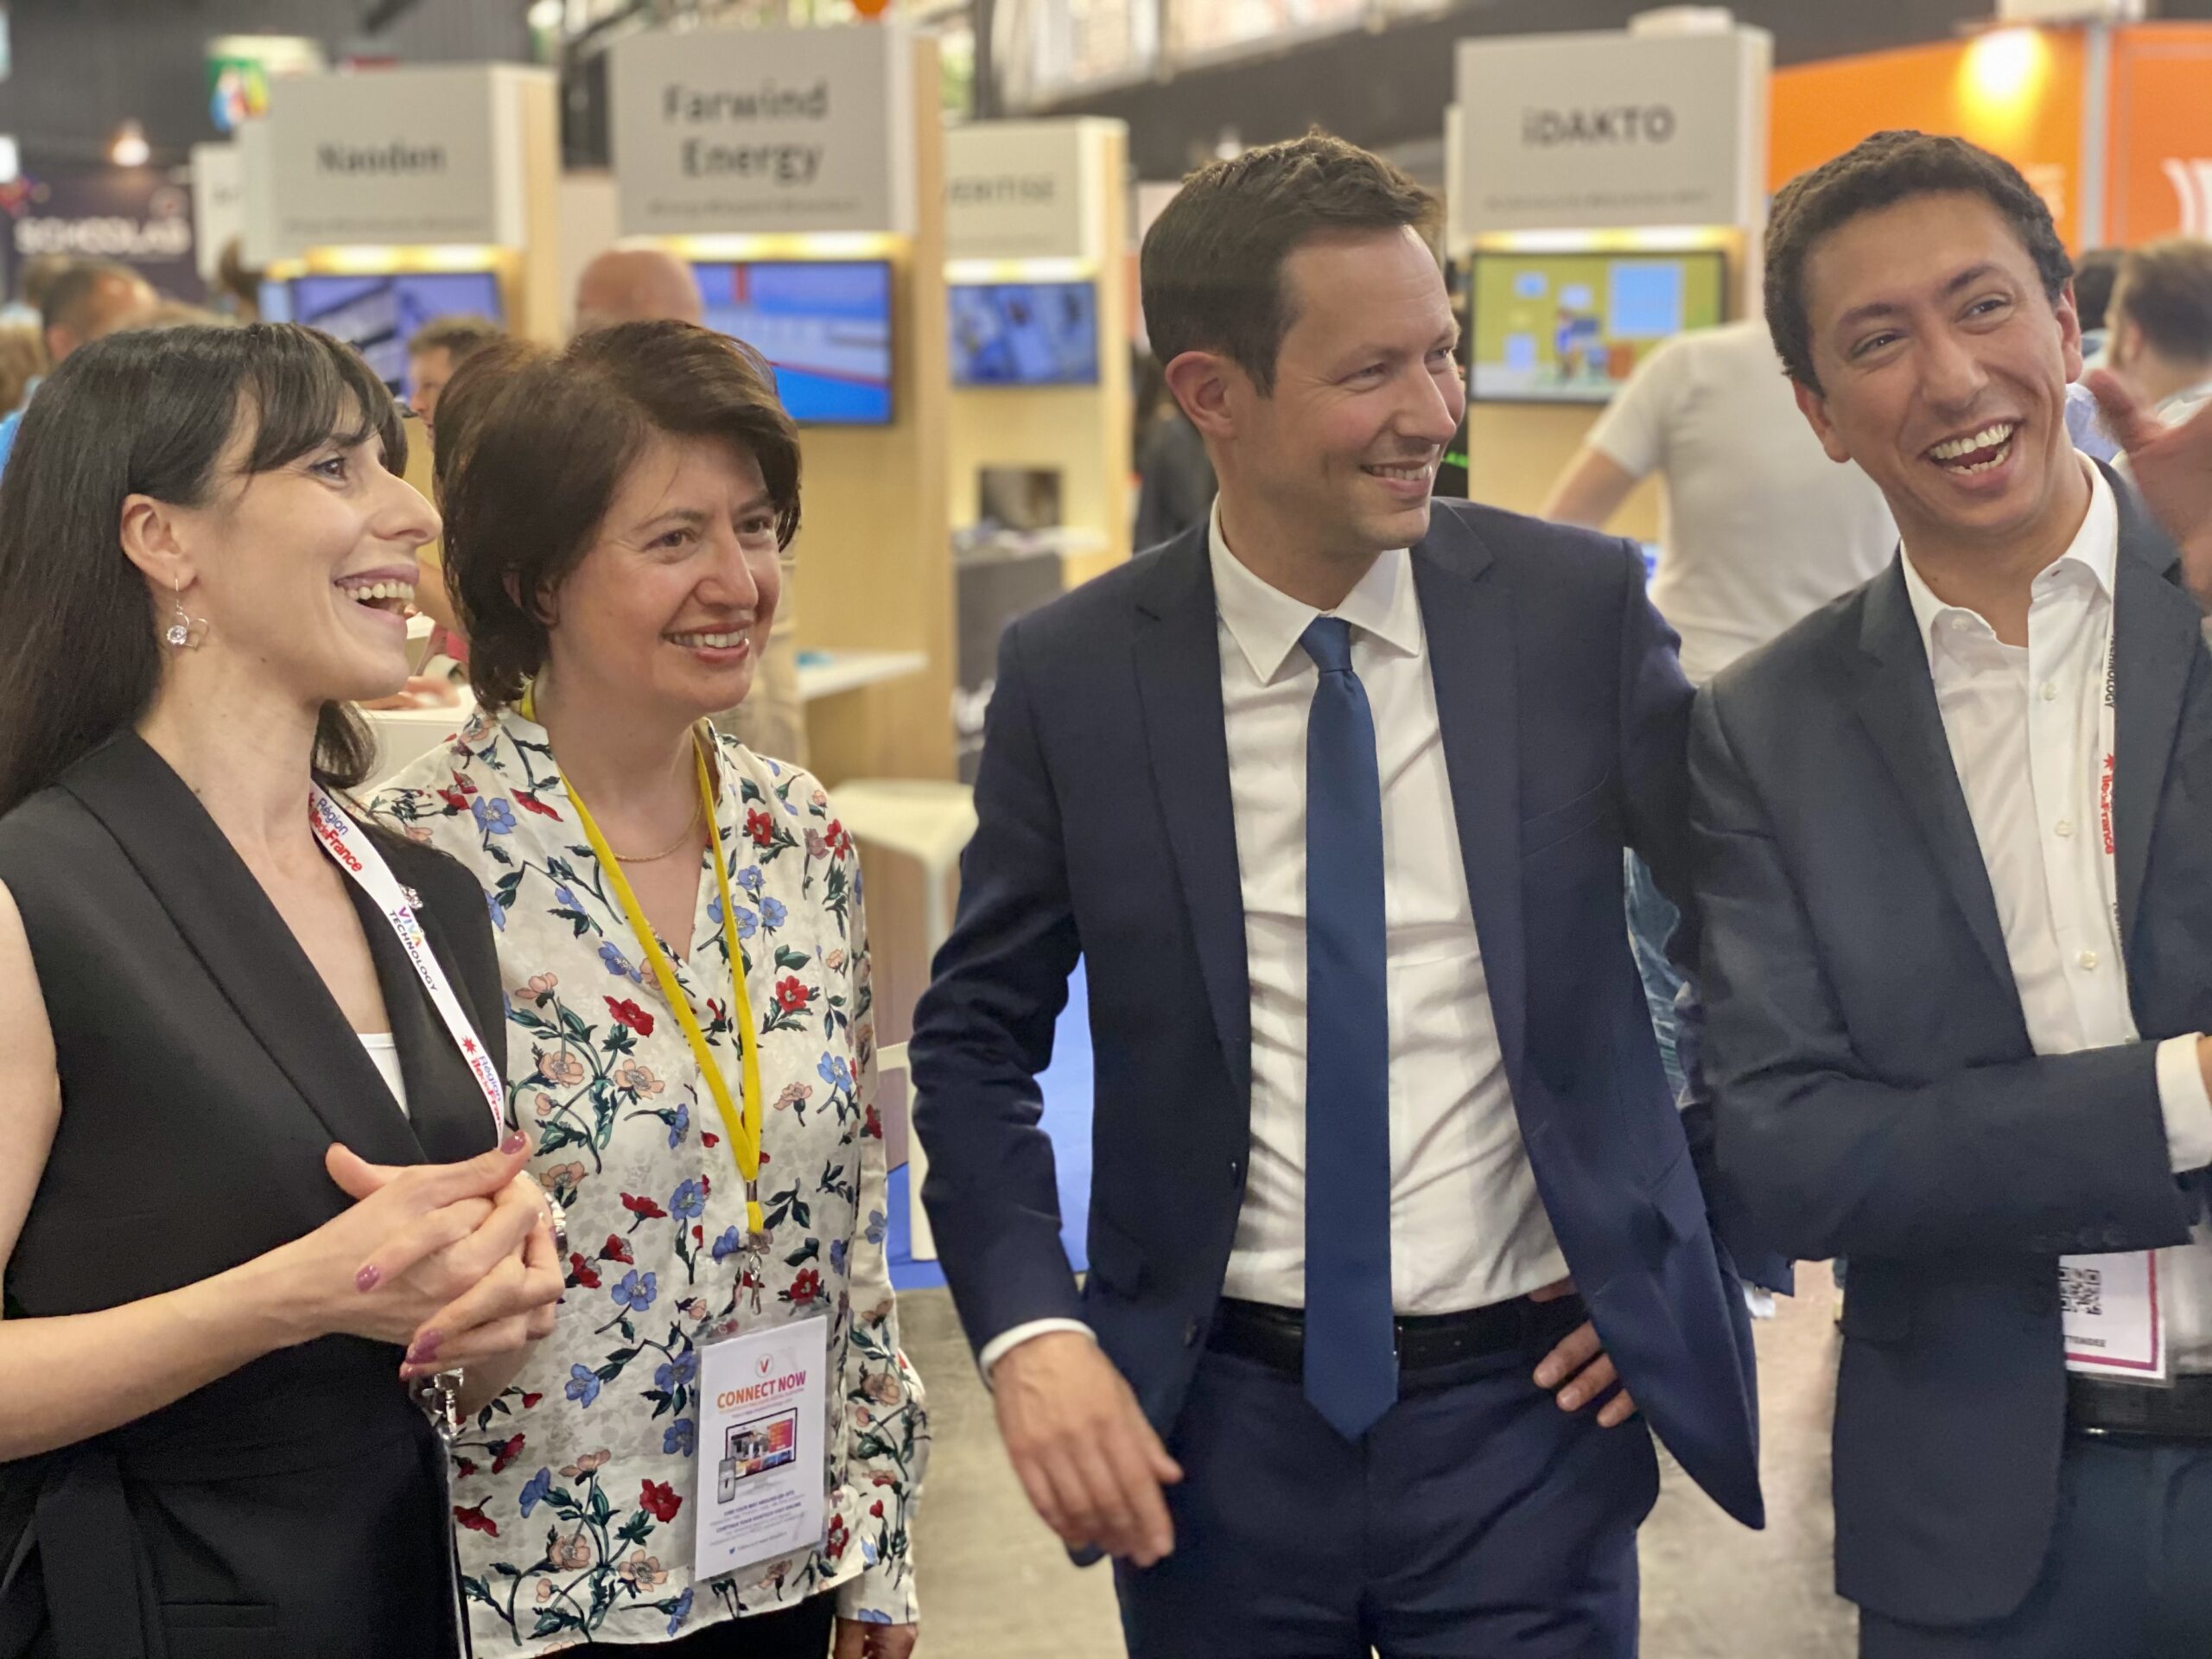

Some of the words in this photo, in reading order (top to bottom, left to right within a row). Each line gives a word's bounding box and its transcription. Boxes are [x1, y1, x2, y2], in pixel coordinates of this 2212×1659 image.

[663, 79, 828, 121] Farwind
[1522, 105, 1675, 146] iDAKTO
[683, 138, 822, 186] Energy
[317, 798, 349, 836] Région
[398, 906, 423, 948] VIVA
[390, 910, 438, 992] TECHNOLOGY
[479, 1055, 501, 1102] Région
[717, 1380, 776, 1408] CONNECT
[779, 1370, 806, 1392] NOW
